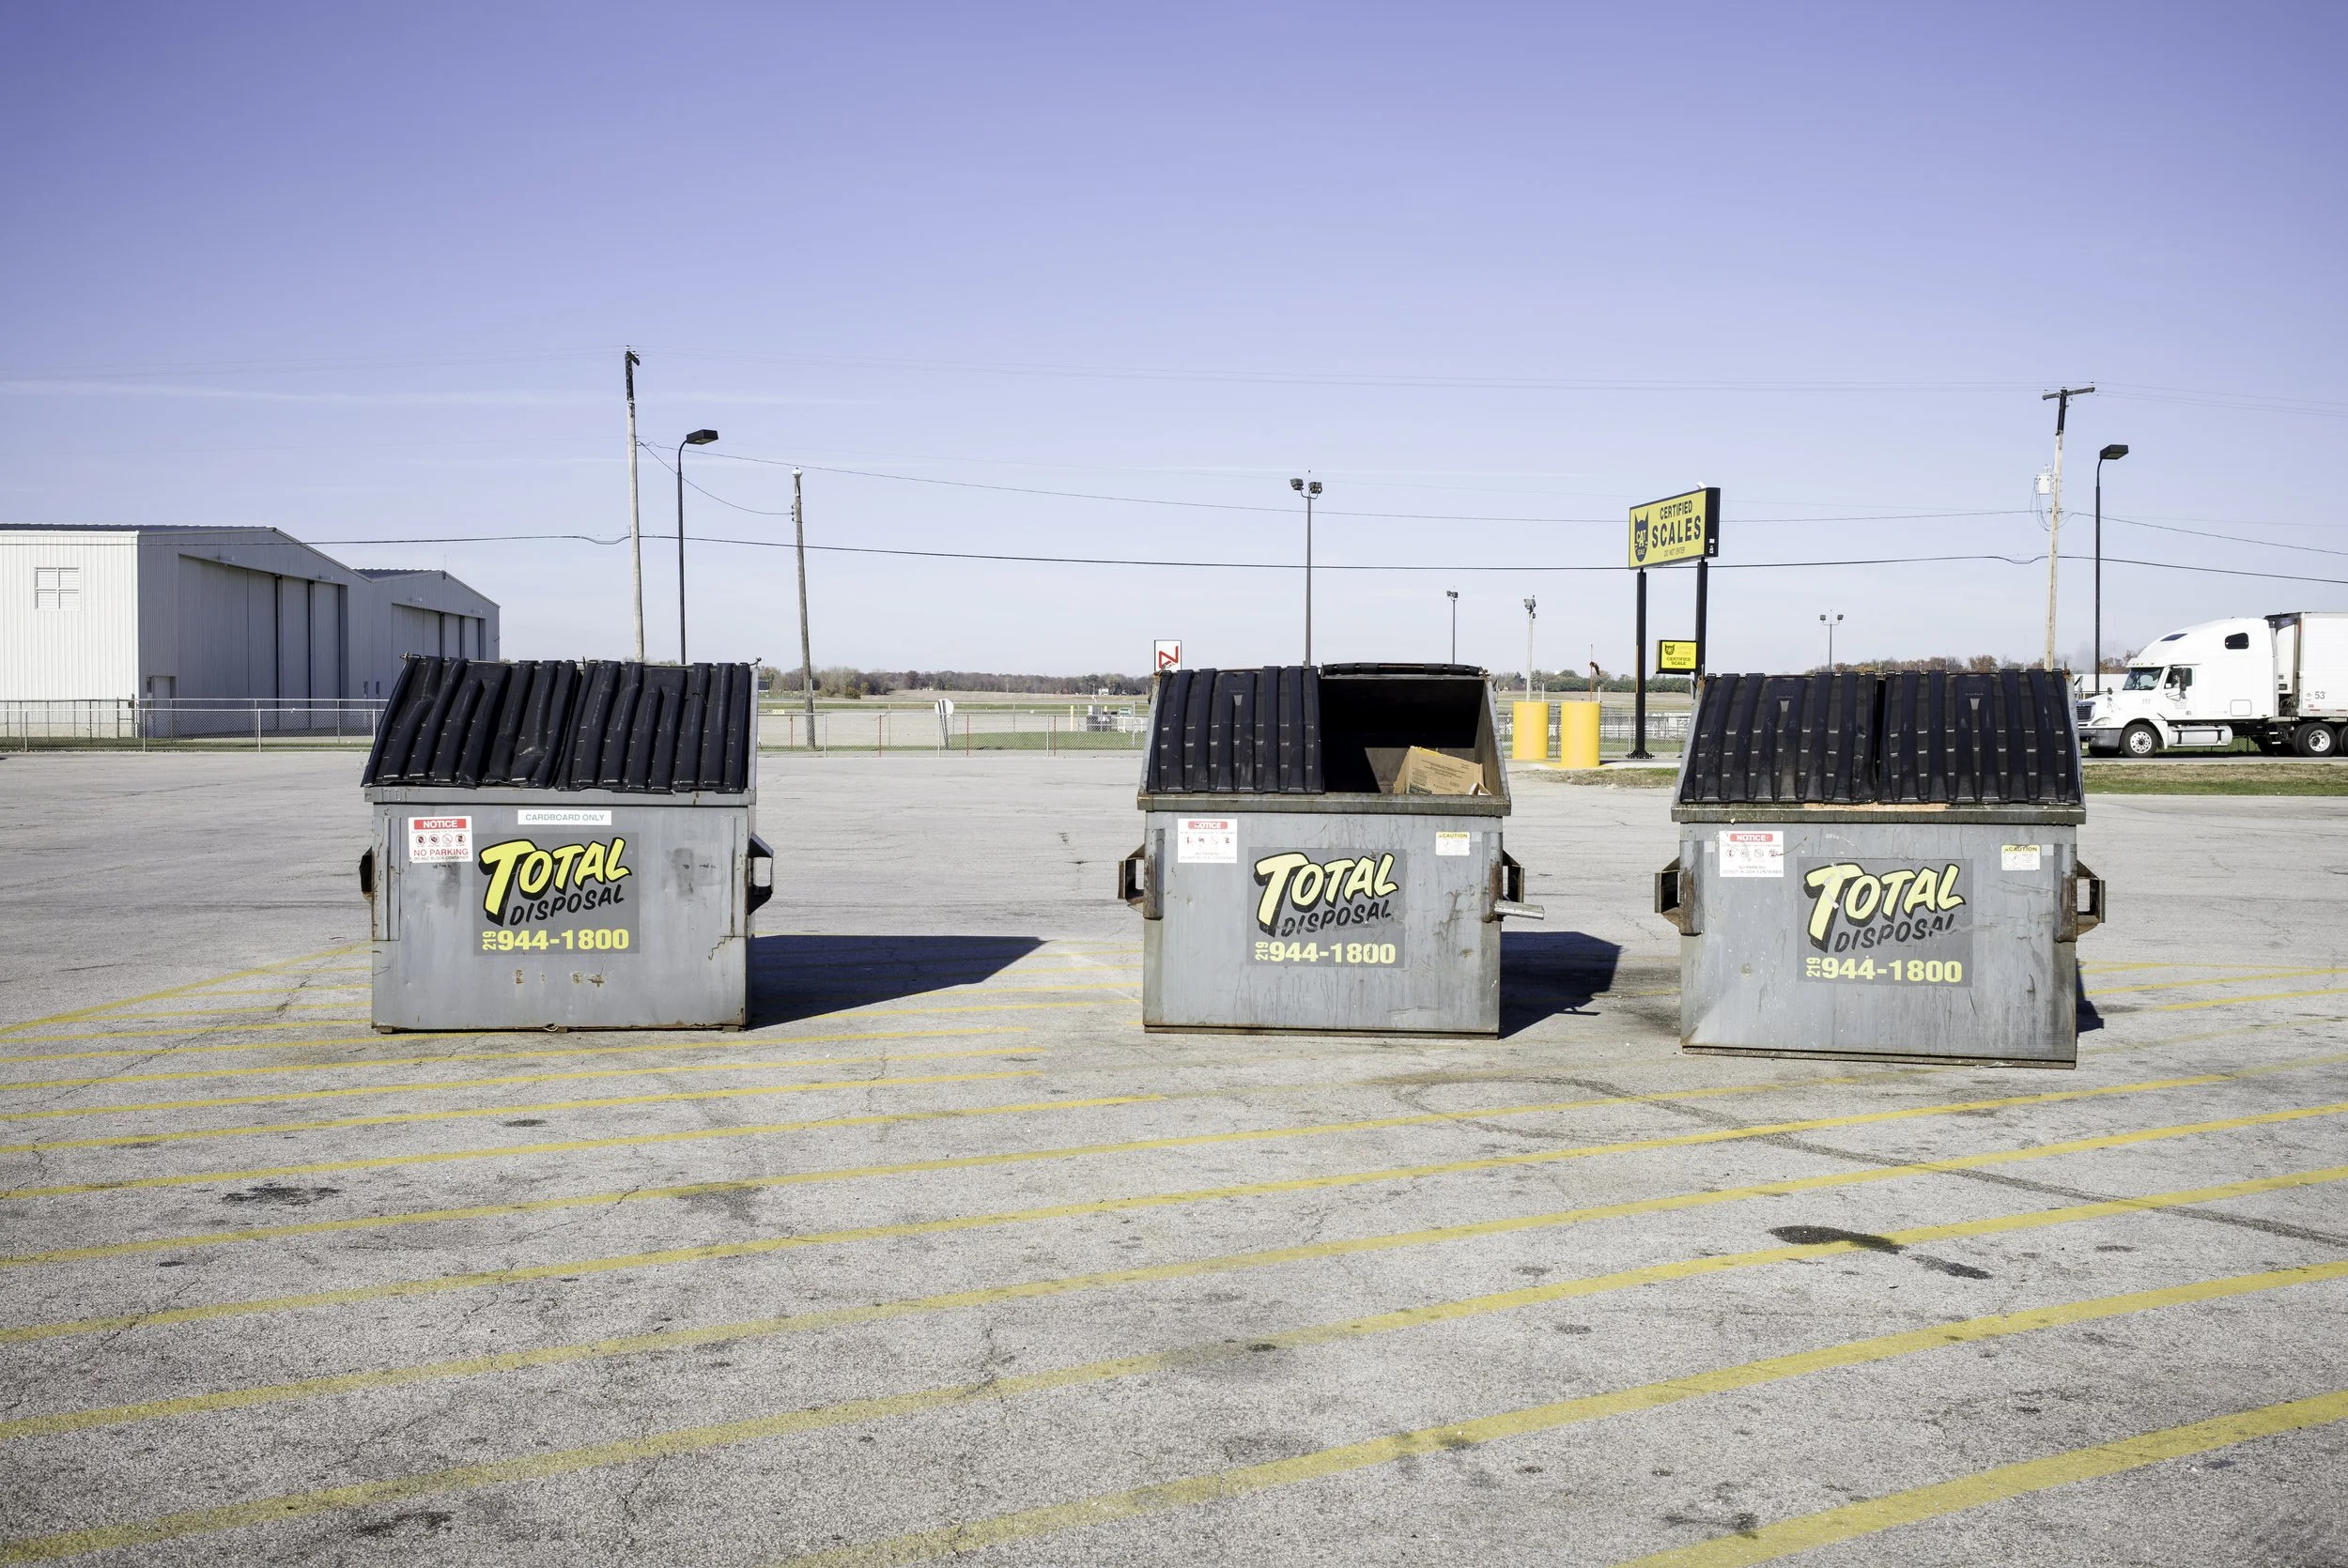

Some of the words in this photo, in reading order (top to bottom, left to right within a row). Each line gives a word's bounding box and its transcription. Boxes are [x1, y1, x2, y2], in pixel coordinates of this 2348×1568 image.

[1661, 500, 1692, 520] CERTIFIED
[1636, 530, 1647, 546] CAT
[1652, 515, 1701, 548] SCALES
[423, 820, 458, 829] NOTICE
[525, 813, 580, 822] CARDBOARD
[429, 848, 469, 856] PARKING
[477, 837, 632, 927] TOTAL
[509, 884, 625, 927] DISPOSAL
[1253, 852, 1398, 937] TOTAL
[1280, 899, 1392, 937] DISPOSAL
[1803, 862, 1967, 953] TOTAL
[482, 930, 497, 951] 219
[497, 929, 629, 951] 944-1800
[1255, 941, 1269, 961] 219
[1269, 941, 1397, 964] 944-1800
[1806, 957, 1821, 977] 219
[1821, 957, 1962, 983] 944-1800
